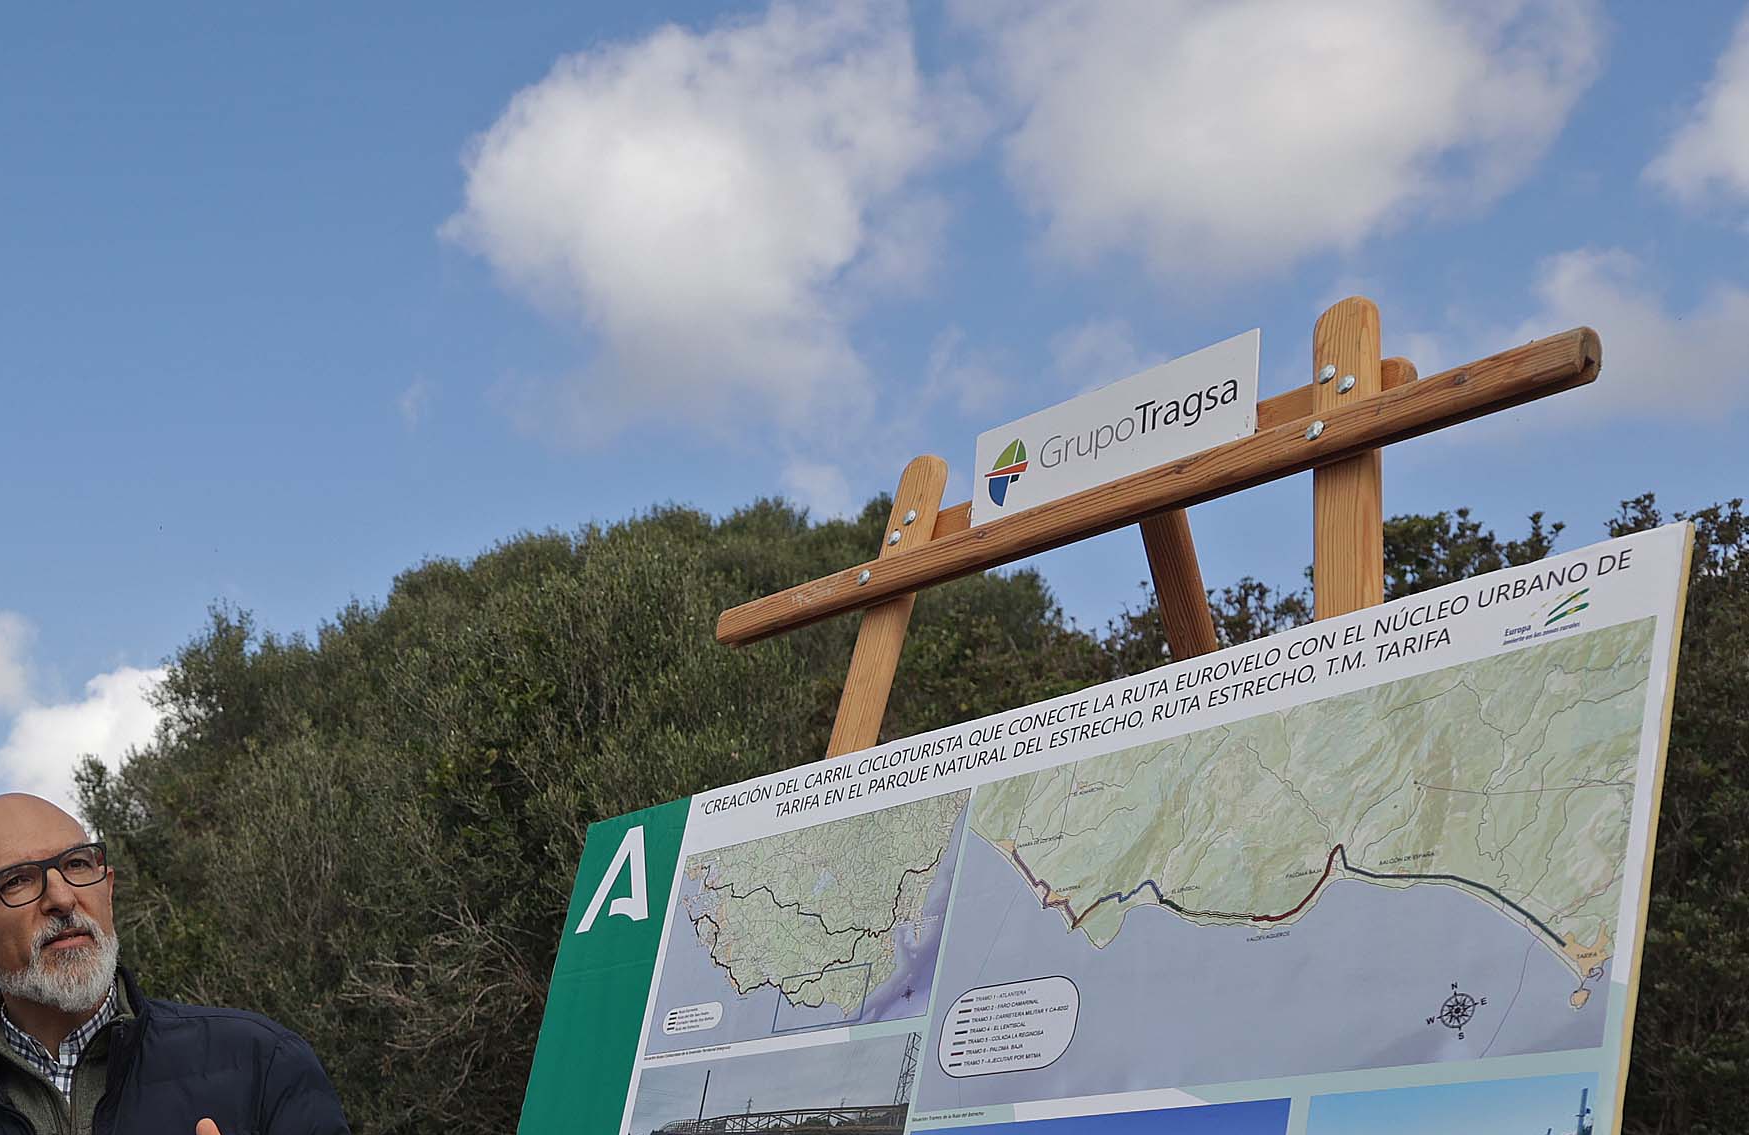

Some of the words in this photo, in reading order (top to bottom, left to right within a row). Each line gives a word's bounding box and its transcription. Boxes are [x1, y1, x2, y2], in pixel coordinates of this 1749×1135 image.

[1039, 379, 1238, 470] GrupoTragsa
[1504, 625, 1531, 637] Europa
[775, 778, 802, 798] DEL
[804, 763, 853, 790] CARRIL
[857, 735, 964, 776] CICLOTURISTA
[968, 723, 1003, 748] QUE
[1008, 700, 1088, 737] CONECTE
[1092, 693, 1115, 714] LA
[1121, 678, 1169, 707] RUTA
[1175, 648, 1280, 693] EUROVELO
[1288, 631, 1336, 660] CON
[1343, 624, 1365, 647] EL
[1373, 595, 1469, 638] NÚCLEO
[1478, 562, 1587, 608] URBANO
[1597, 548, 1633, 577] DE
[775, 794, 820, 818] TARIFA
[824, 788, 844, 806] EN
[848, 783, 863, 801] EL
[867, 767, 928, 798] PARQUE
[933, 751, 1007, 783] NATURAL
[1013, 739, 1043, 760] DEL
[1048, 710, 1145, 748] ESTRECHO,
[1151, 698, 1201, 724] RUTA
[1207, 665, 1317, 708] ESTRECHO,
[1326, 652, 1366, 678] T.M.
[1376, 627, 1451, 663] TARIFA
[1480, 998, 1487, 1006] E
[1426, 1016, 1435, 1025] W
[1458, 1032, 1465, 1040] S
